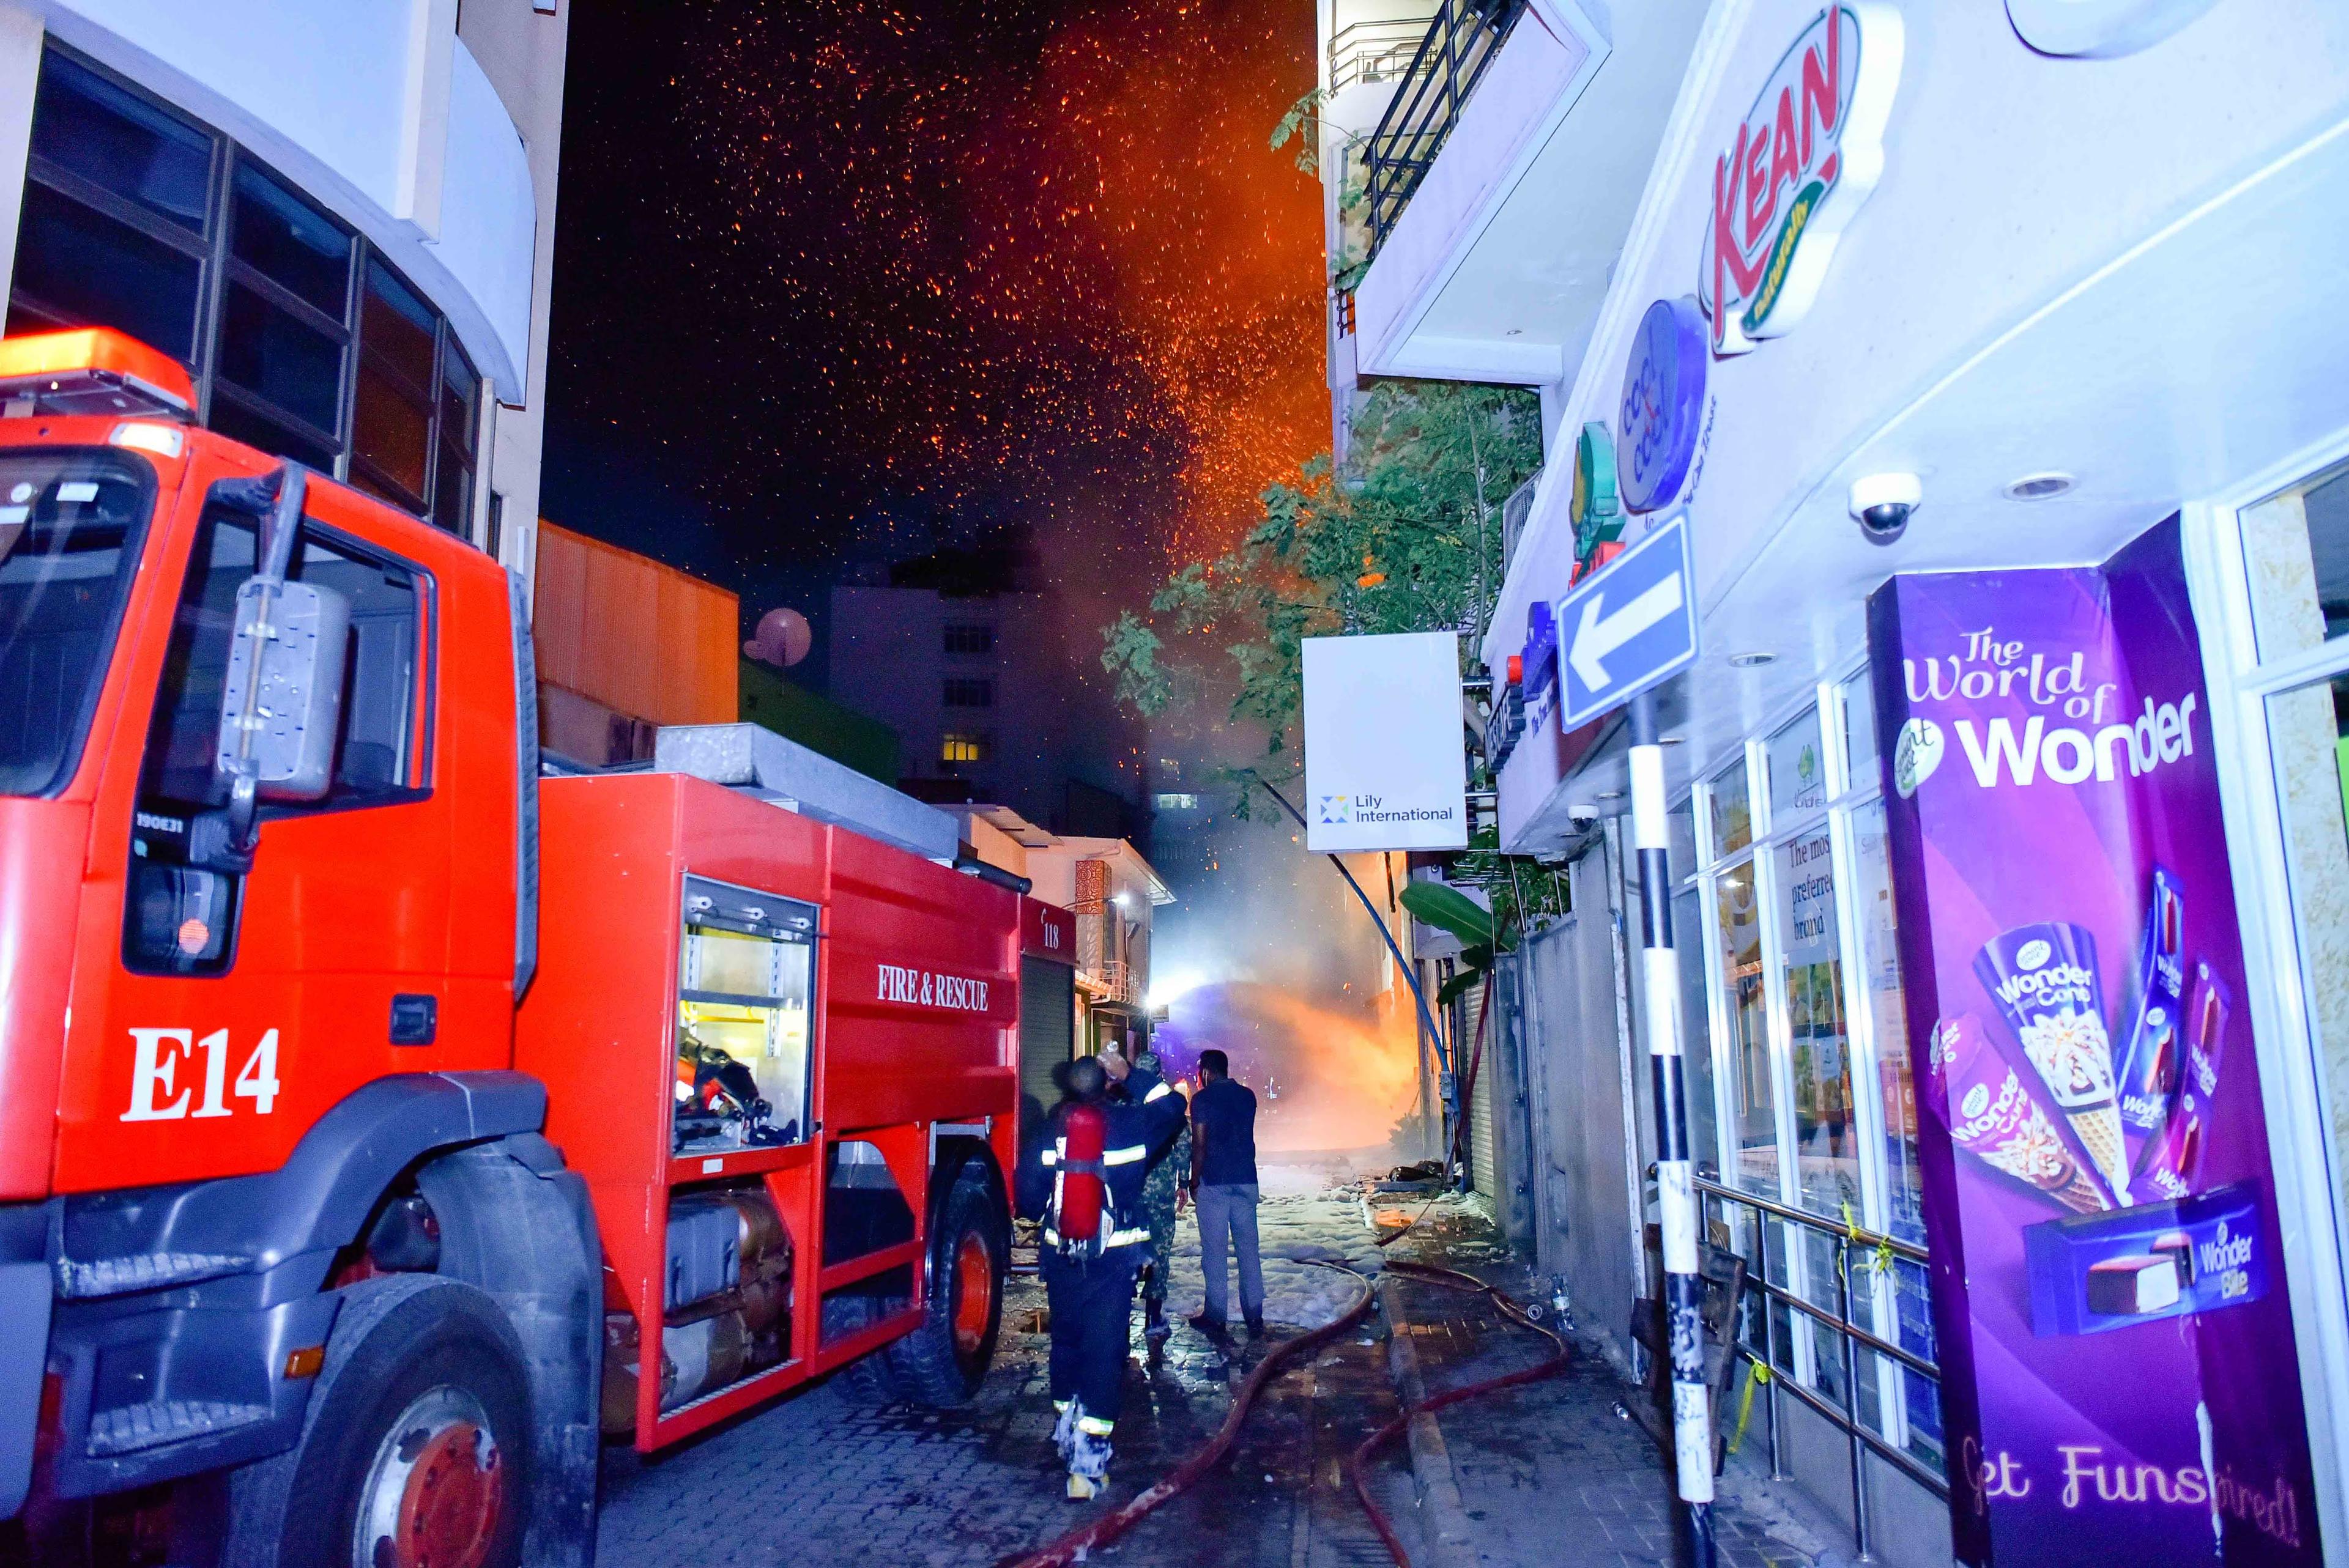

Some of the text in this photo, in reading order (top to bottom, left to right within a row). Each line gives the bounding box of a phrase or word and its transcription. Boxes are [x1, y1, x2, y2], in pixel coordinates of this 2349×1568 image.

[1713, 4, 1839, 341] KEAN
[1959, 626, 2024, 666] The
[1902, 651, 2088, 705] World
[2063, 684, 2117, 724] of
[1954, 692, 2197, 788] Wonder
[1356, 795, 1382, 809] Lily
[1356, 807, 1453, 823] International
[1789, 840, 1807, 868] The
[1809, 834, 1830, 860] mos
[1044, 922, 1059, 949] 118
[1793, 908, 1825, 940] brand
[877, 964, 989, 1011] FIRE & RESCUE
[1995, 962, 2092, 1004] Wonder
[119, 1027, 281, 1122] E14
[2200, 1233, 2252, 1273] Wonder
[1962, 1435, 2030, 1517] Get
